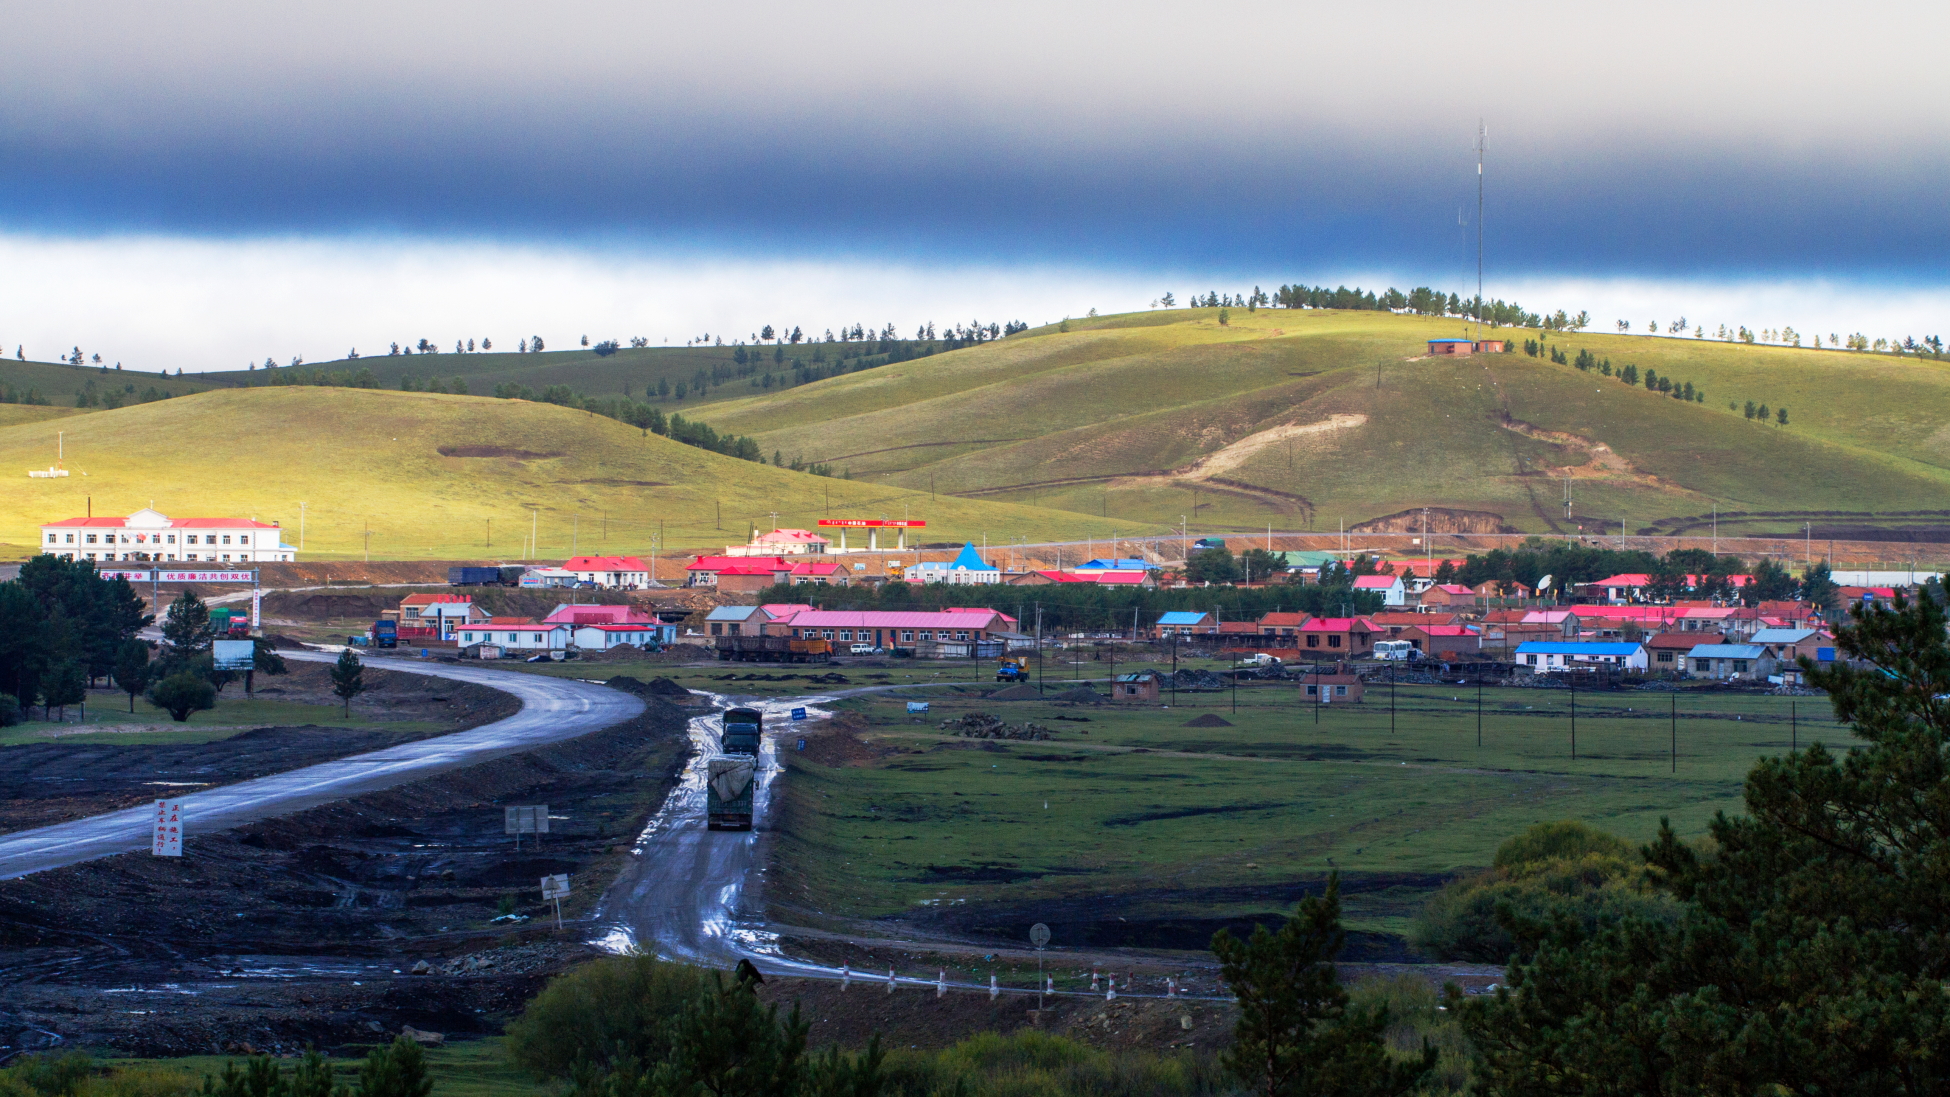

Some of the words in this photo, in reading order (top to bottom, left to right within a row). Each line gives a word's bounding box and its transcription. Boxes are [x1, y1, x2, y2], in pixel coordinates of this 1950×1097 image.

[166, 572, 250, 580] 优质廉洁共创双优
